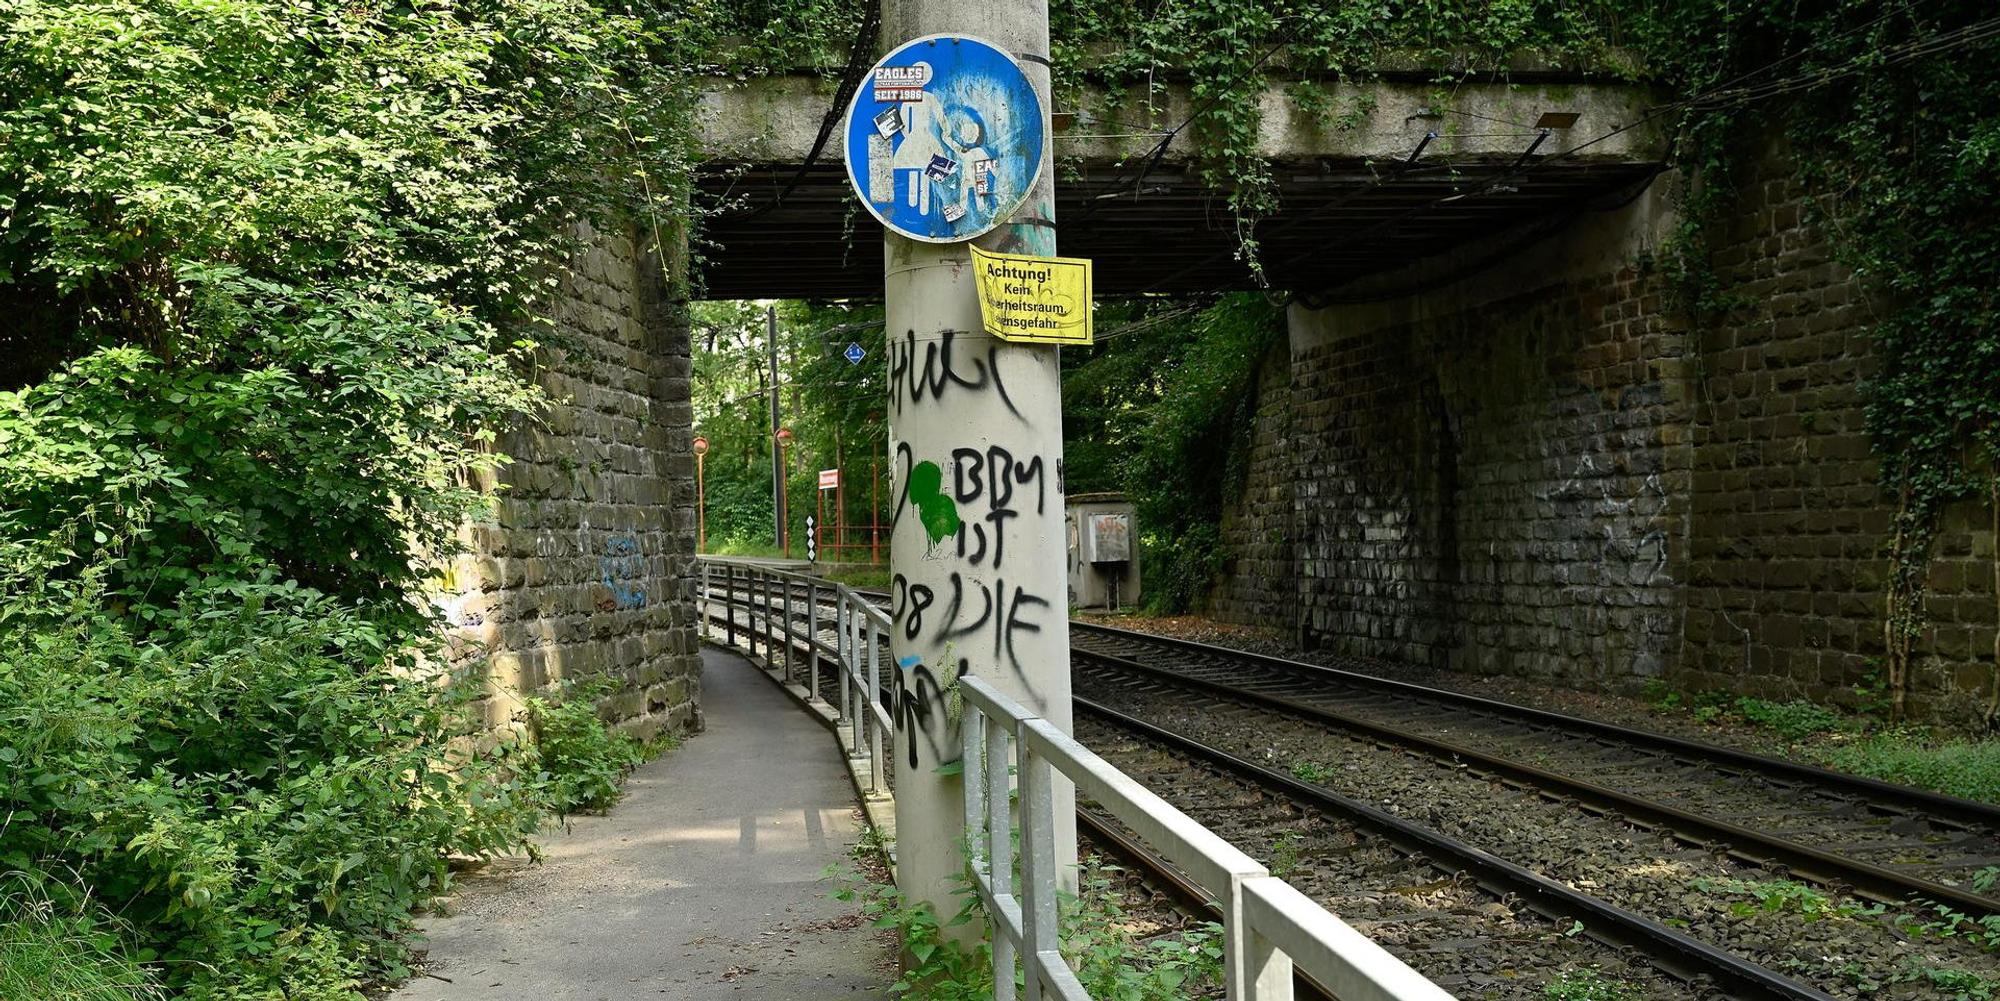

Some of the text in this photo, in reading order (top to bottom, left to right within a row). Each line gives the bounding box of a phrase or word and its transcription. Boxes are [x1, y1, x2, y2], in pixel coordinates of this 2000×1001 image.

[875, 68, 923, 80] EAGLES
[875, 90, 922, 101] SEIT 1986
[987, 263, 1052, 283] Achtung!
[1004, 283, 1031, 295] Kein
